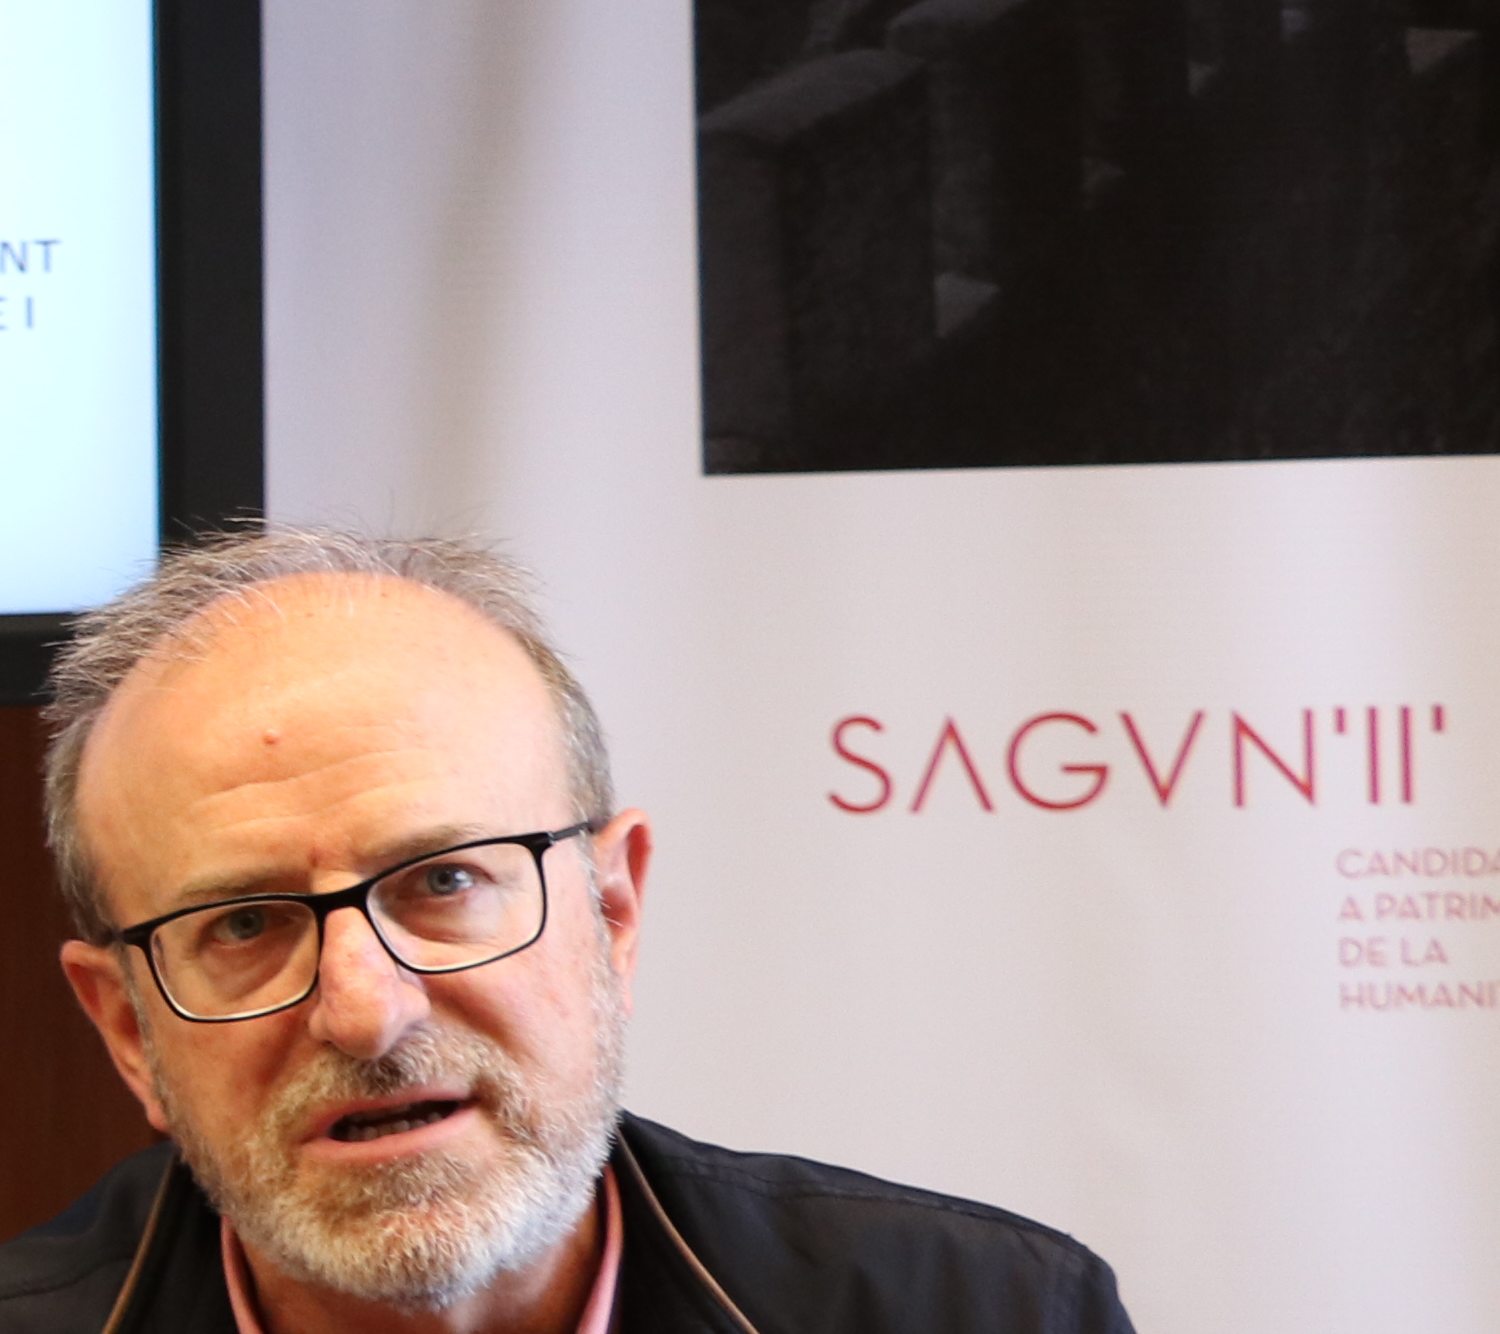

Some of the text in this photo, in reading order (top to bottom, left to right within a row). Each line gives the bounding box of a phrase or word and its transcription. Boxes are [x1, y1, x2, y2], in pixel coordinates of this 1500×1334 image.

[1338, 895, 1363, 921] A
[1339, 937, 1449, 967] DE LA
[1339, 980, 1500, 1010] HUMANI
